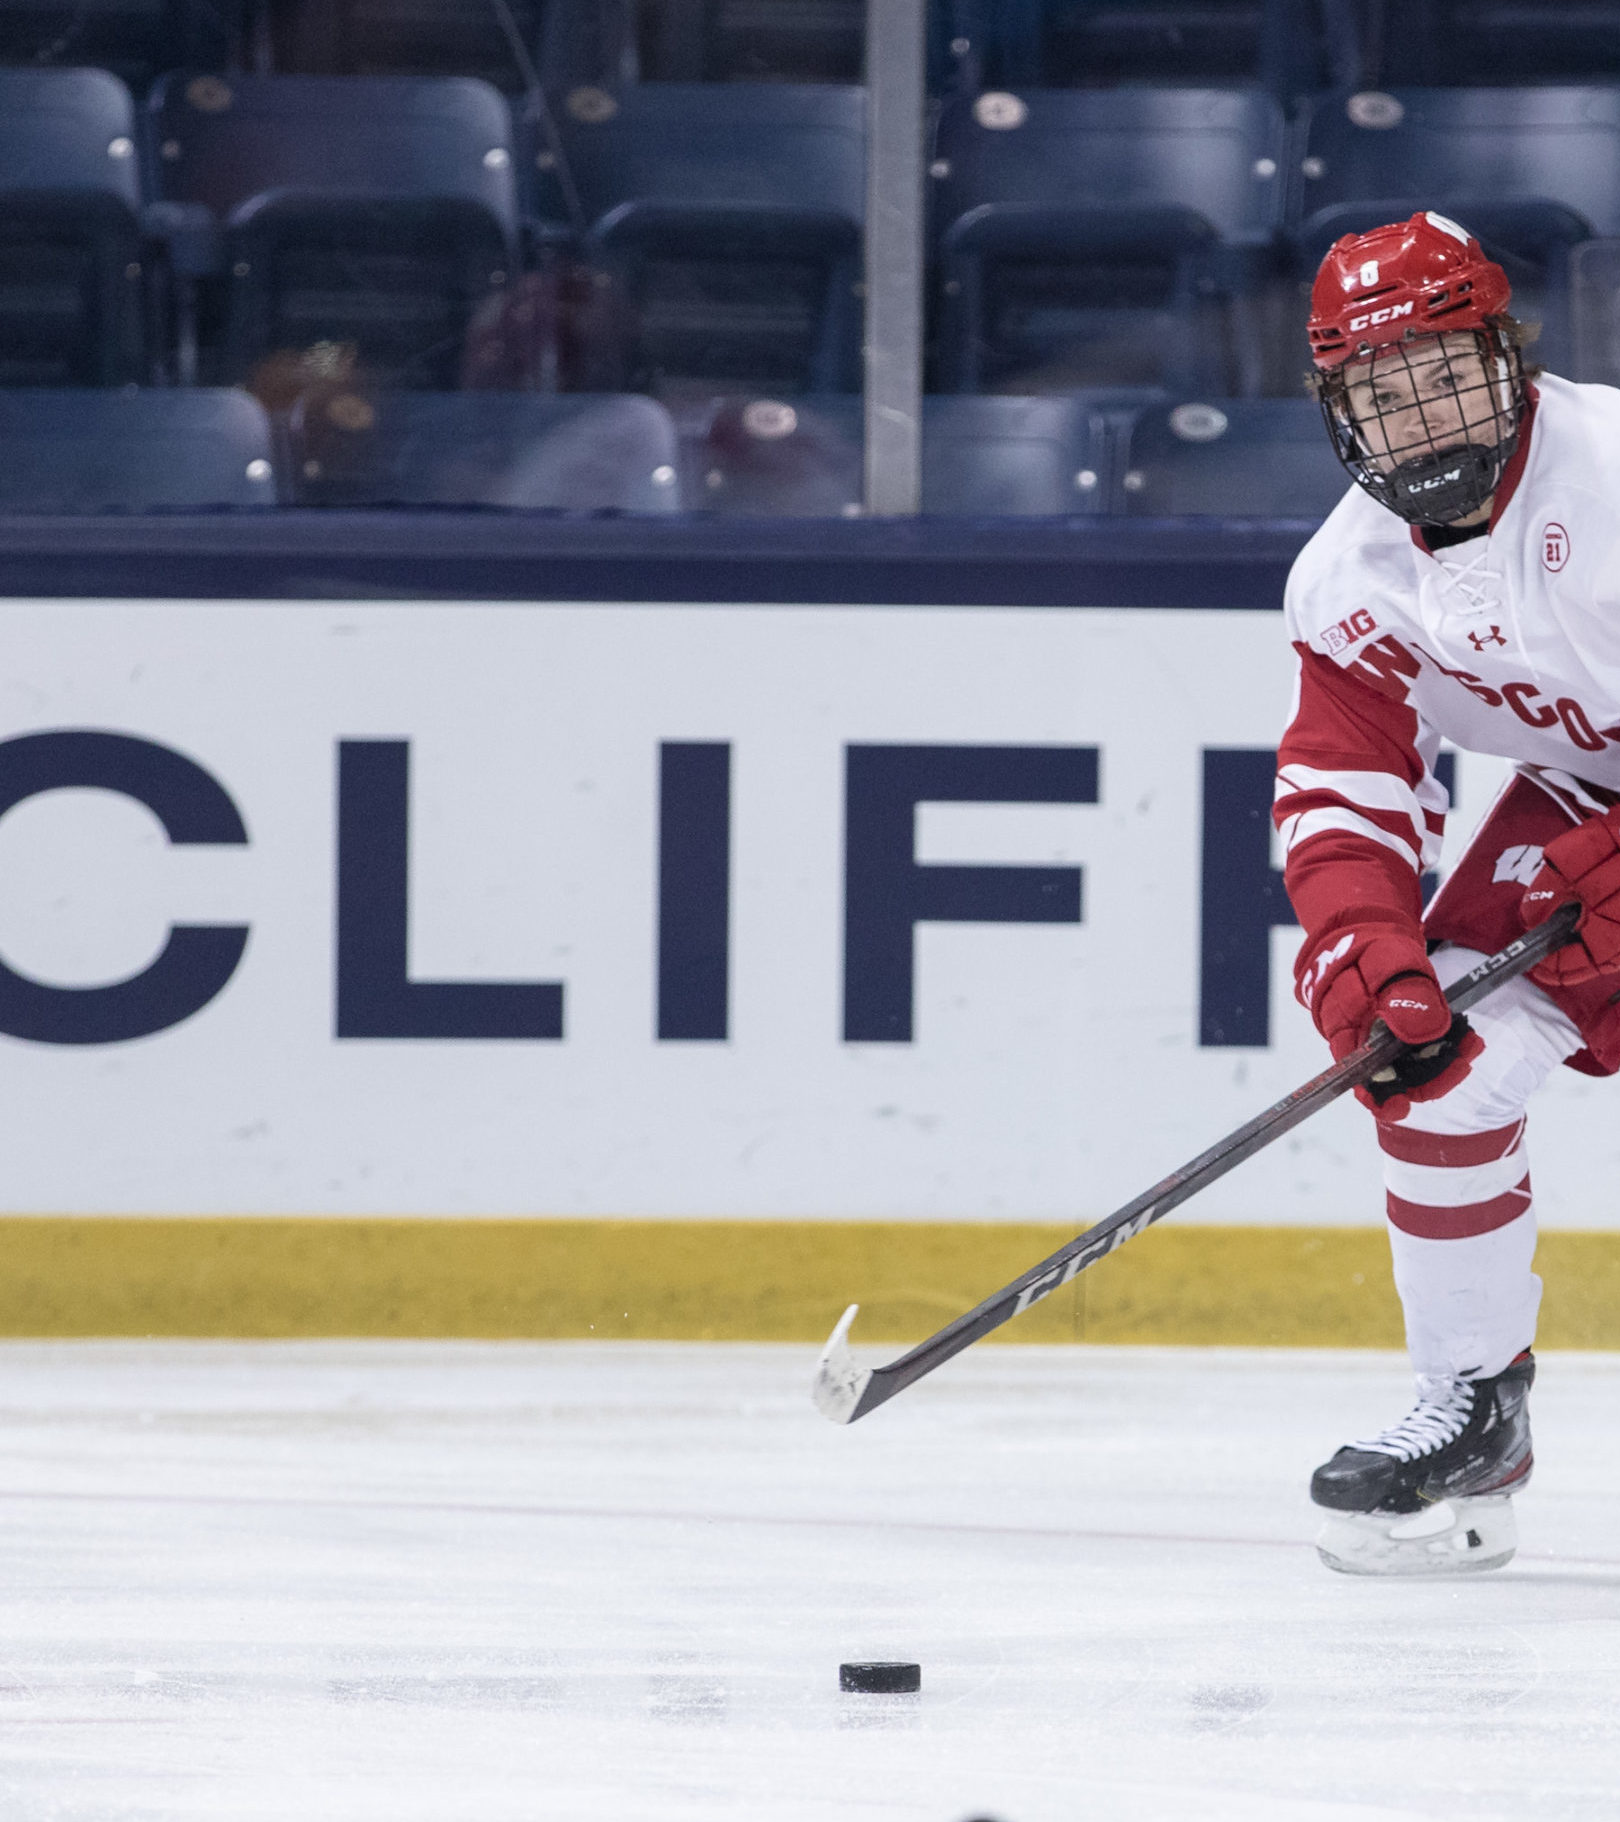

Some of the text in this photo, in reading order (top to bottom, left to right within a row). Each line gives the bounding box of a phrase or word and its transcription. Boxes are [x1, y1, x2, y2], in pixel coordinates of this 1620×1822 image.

[1360, 260, 1379, 287] 8
[1350, 301, 1414, 332] CCM
[1408, 469, 1461, 493] CCM
[1389, 999, 1428, 1011] CCM
